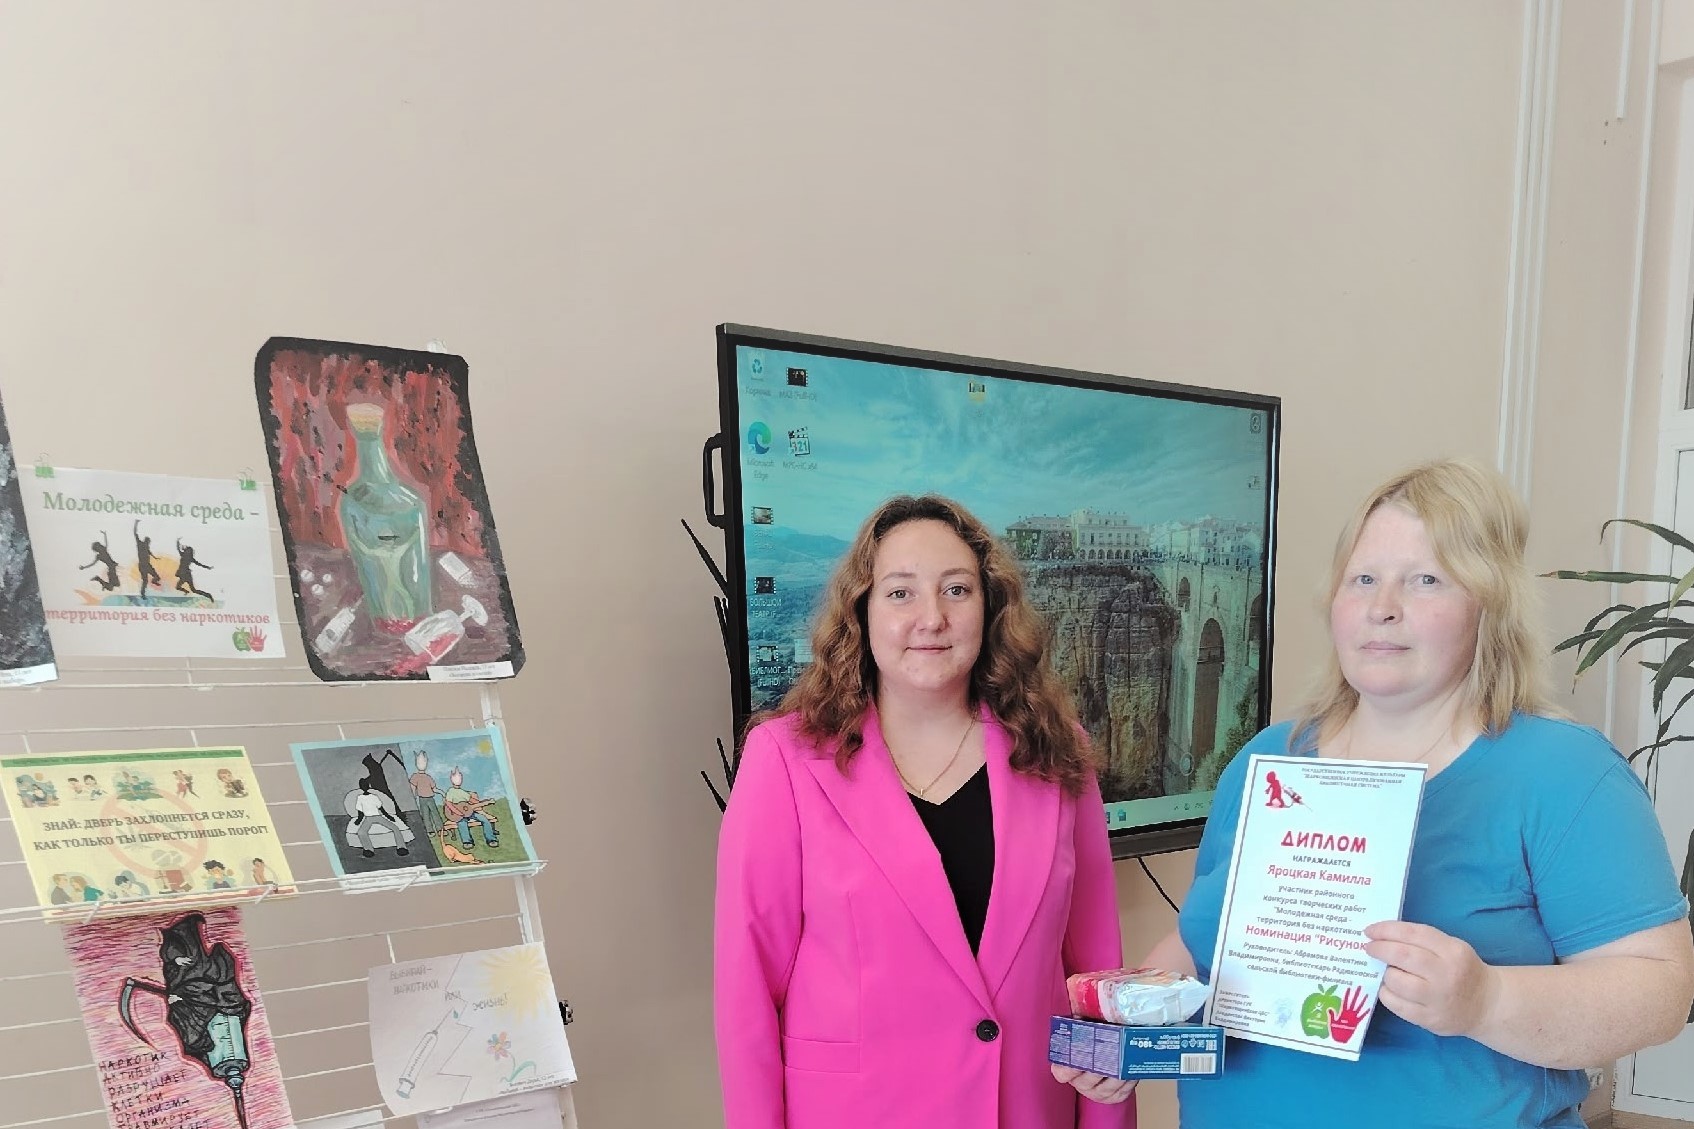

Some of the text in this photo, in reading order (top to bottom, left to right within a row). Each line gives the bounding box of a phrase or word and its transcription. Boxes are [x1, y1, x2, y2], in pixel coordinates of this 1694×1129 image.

[42, 491, 184, 518] Молодежная
[190, 501, 245, 524] среда
[45, 608, 271, 625] территория без наркотиков
[43, 808, 250, 832] ЗНАЙ: ДВЕРЬ ЗАХЛОПНЕТСЯ СРАЗУ,
[34, 839, 62, 851] КАК
[63, 836, 114, 850] ТОЛЬКО
[116, 833, 137, 845] ТЫ
[139, 827, 226, 844] ПЕРЕСТУПИШЬ
[1281, 830, 1367, 854] ДИПЛОМ
[1292, 855, 1352, 868] НАГРАЖДАЕТСЯ
[1267, 864, 1372, 886] Яроцкая Камилла
[1278, 885, 1355, 900] участник районного
[1263, 894, 1367, 914] конкурса творческих работ
[1257, 916, 1301, 929] территория
[1302, 921, 1315, 930] без
[1325, 914, 1348, 924] среда
[1245, 924, 1312, 943] Номинация
[98, 1052, 169, 1071] НАРКОТИК
[103, 1064, 161, 1085] АКТИВНО
[108, 1068, 188, 1096] РАЗРУШАЕТ
[111, 1091, 164, 1113] КЛЕТКИ
[115, 1098, 191, 1123] ОРГАНИЗМА
